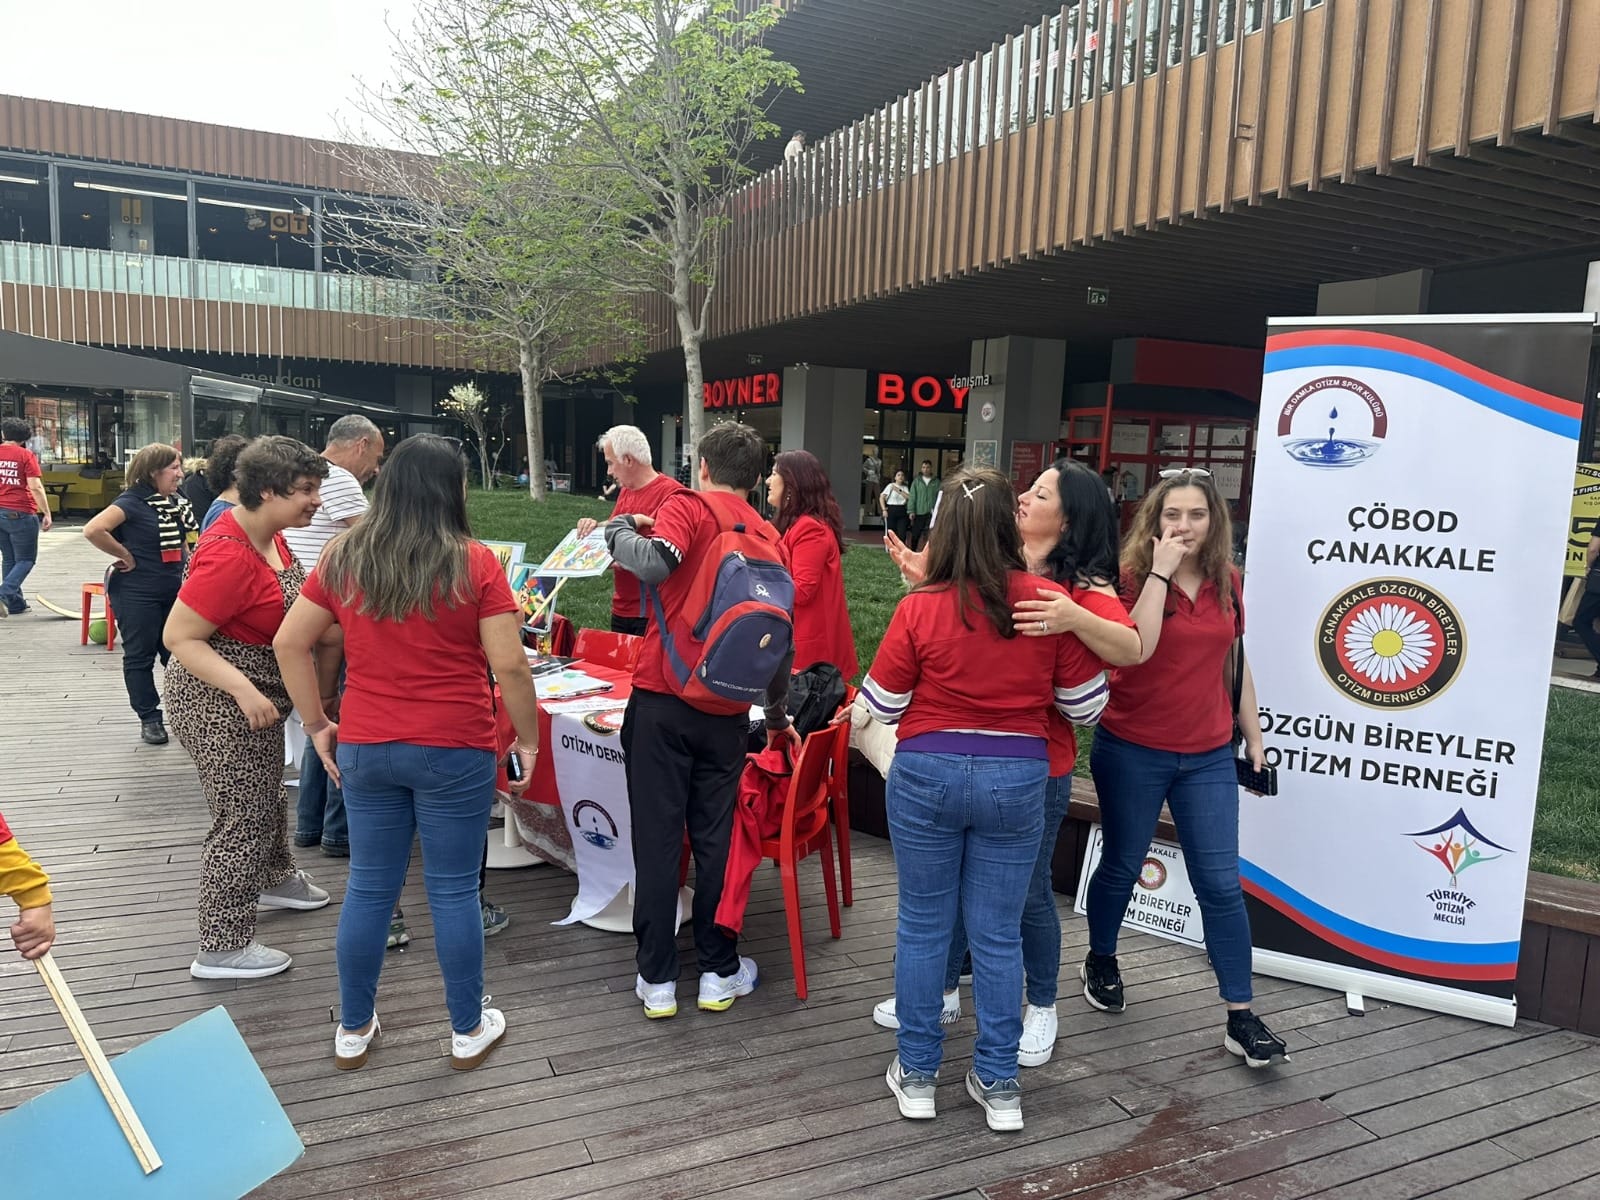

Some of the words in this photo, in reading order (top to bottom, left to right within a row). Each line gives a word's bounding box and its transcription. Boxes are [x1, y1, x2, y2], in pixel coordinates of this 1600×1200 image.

[273, 216, 306, 230] OT
[703, 373, 780, 408] BOYNER
[950, 374, 989, 388] danışma
[1283, 404, 1294, 416] BİR
[1293, 385, 1315, 404] DAMLA
[1316, 379, 1340, 389] OTİZM
[1341, 380, 1363, 393] SPOR
[1362, 390, 1384, 417] KULÜBÜ
[1348, 502, 1458, 533] ÇÖBOD
[1307, 539, 1496, 572] ÇANAKKALE
[1323, 586, 1376, 644] ÇANAKKALE
[1379, 584, 1427, 602] ÖZGÜN
[1426, 598, 1458, 656] BİREYLER
[1337, 673, 1371, 699] OTİZM
[1374, 682, 1430, 703] DERNEĞİ
[562, 735, 594, 757] OTİZM
[595, 745, 625, 765] DERN
[1258, 707, 1355, 744] ÖZGÜN
[1364, 723, 1516, 765] BİREYLER
[1264, 746, 1351, 778] OTİZM
[1360, 759, 1498, 799] DERNEĞİ
[1149, 846, 1178, 859] AKKALE
[1140, 892, 1192, 917] BİREYLER
[1426, 889, 1476, 910] TÜRKİYE
[1435, 901, 1465, 915] OTİZM
[1137, 910, 1185, 933] DERNEĞİ
